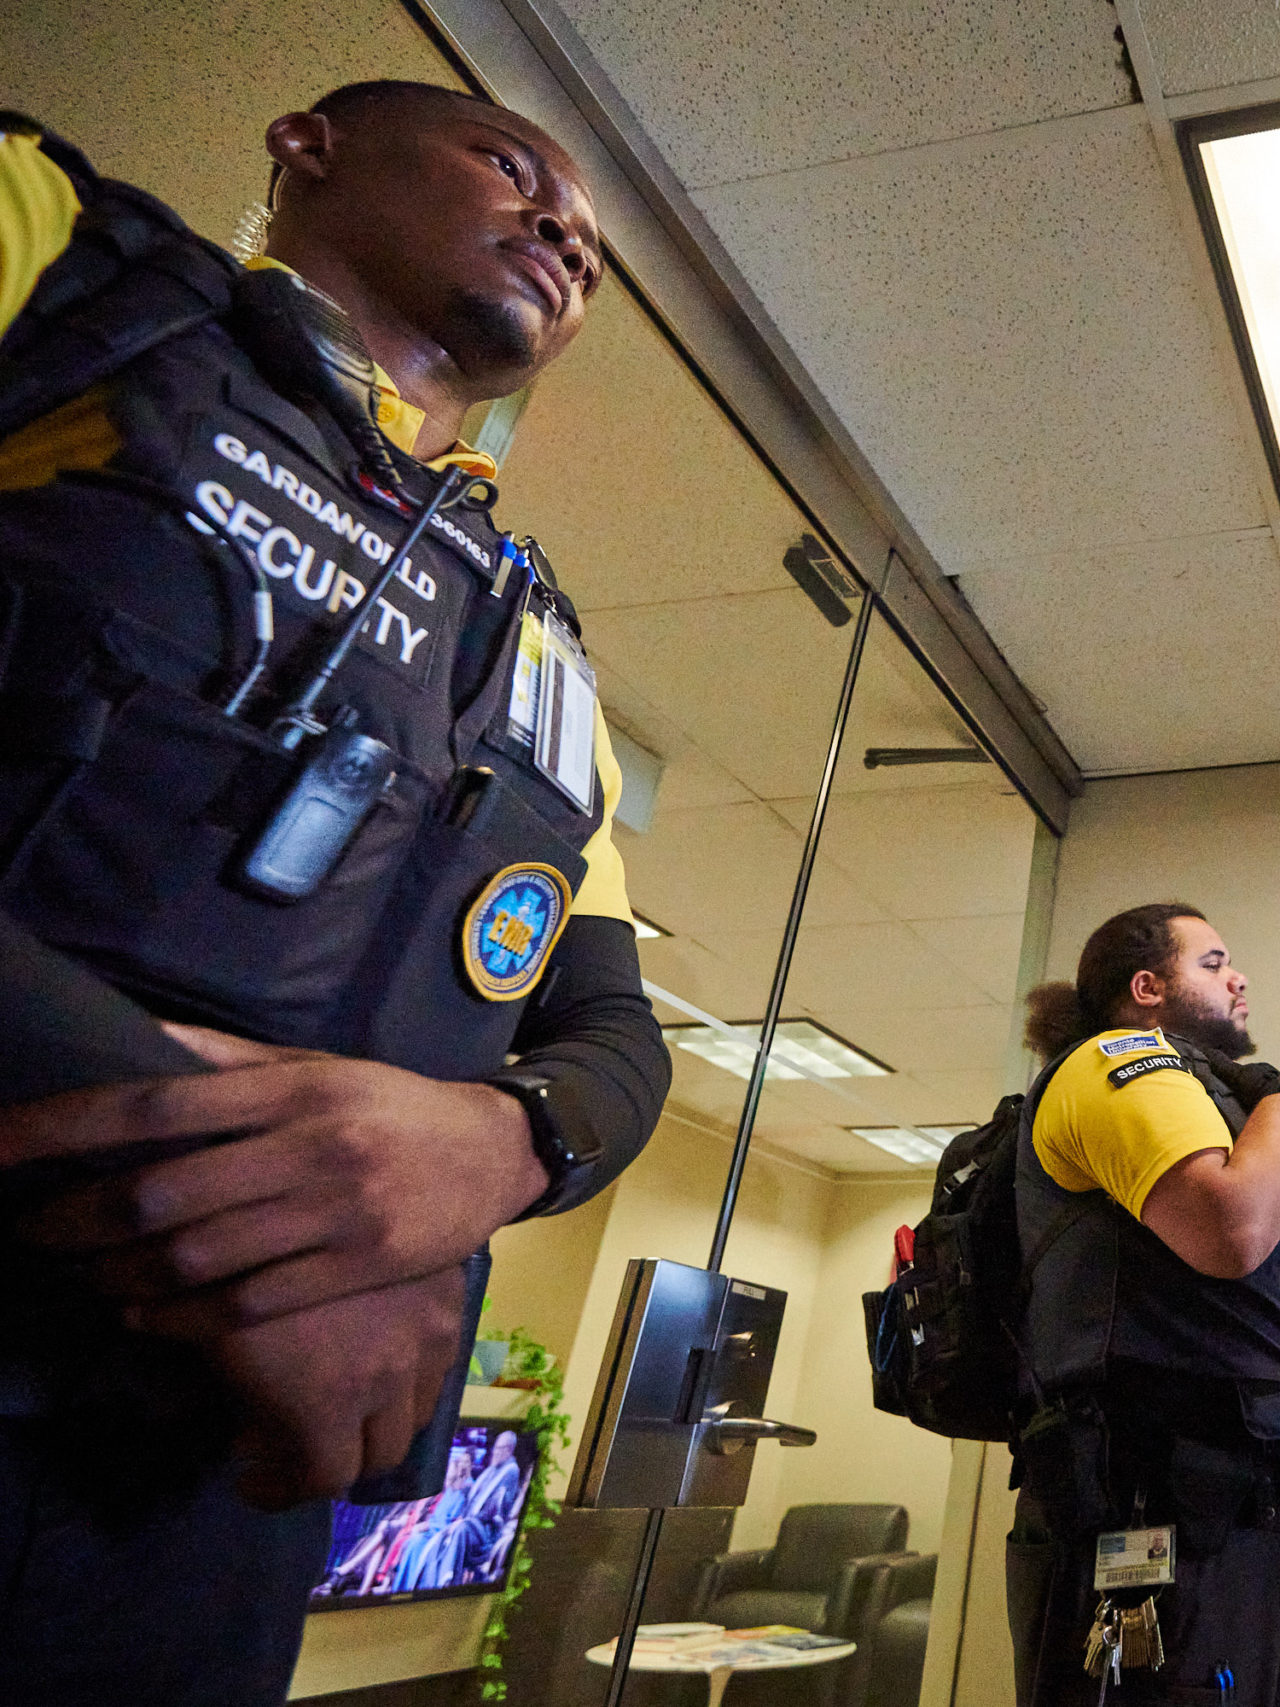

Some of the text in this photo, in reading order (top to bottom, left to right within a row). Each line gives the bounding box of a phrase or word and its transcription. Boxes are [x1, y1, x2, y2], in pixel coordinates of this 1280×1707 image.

[186, 481, 428, 663] SECURTY
[488, 911, 534, 957] EMR
[1117, 1057, 1182, 1079] SECURITY
